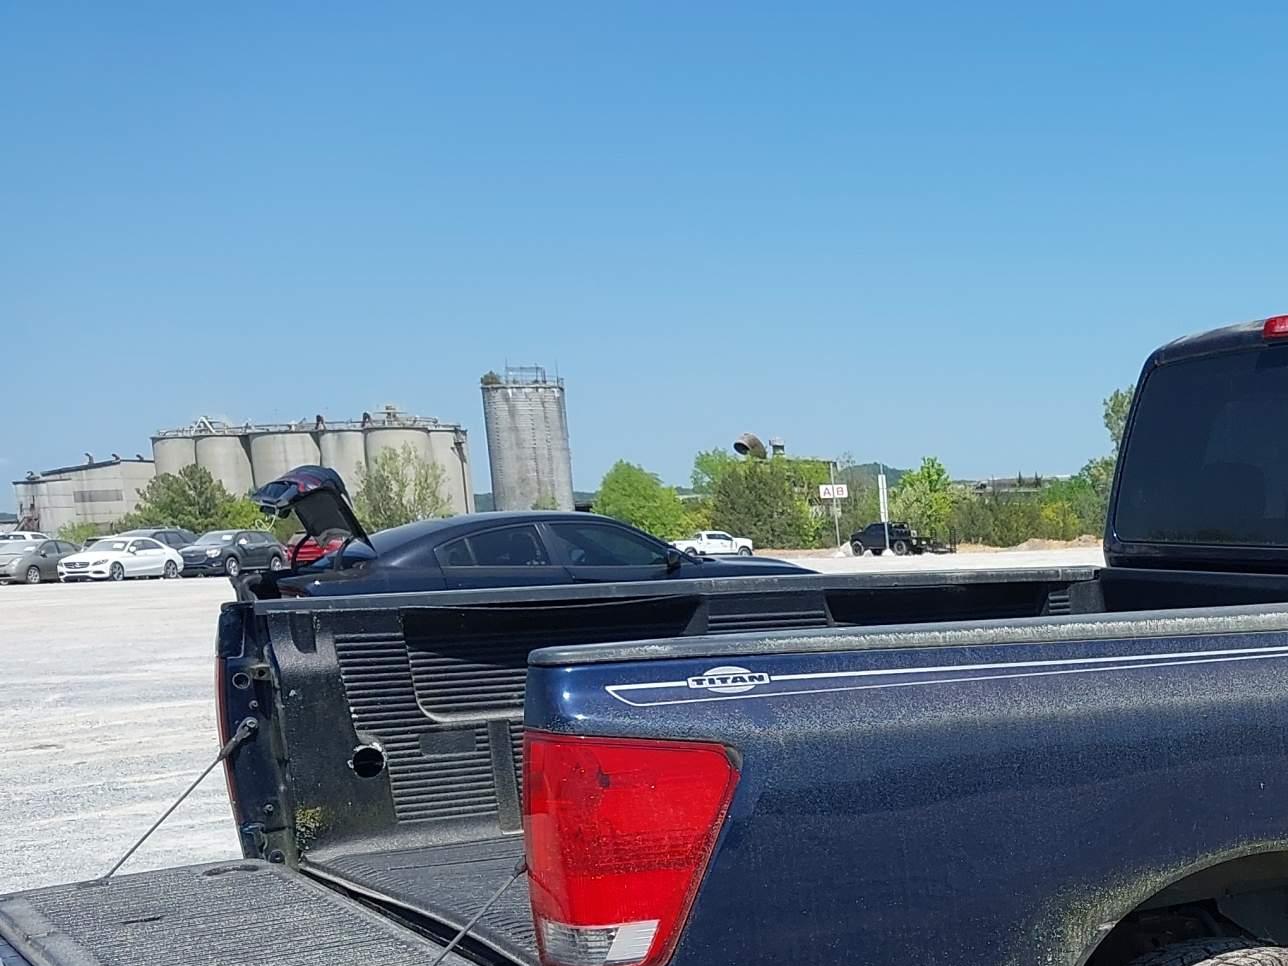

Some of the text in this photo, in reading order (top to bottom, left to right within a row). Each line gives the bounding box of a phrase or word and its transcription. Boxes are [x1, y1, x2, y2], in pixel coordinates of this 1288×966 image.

[823, 486, 844, 497] A B
[691, 674, 765, 686] TITAN
